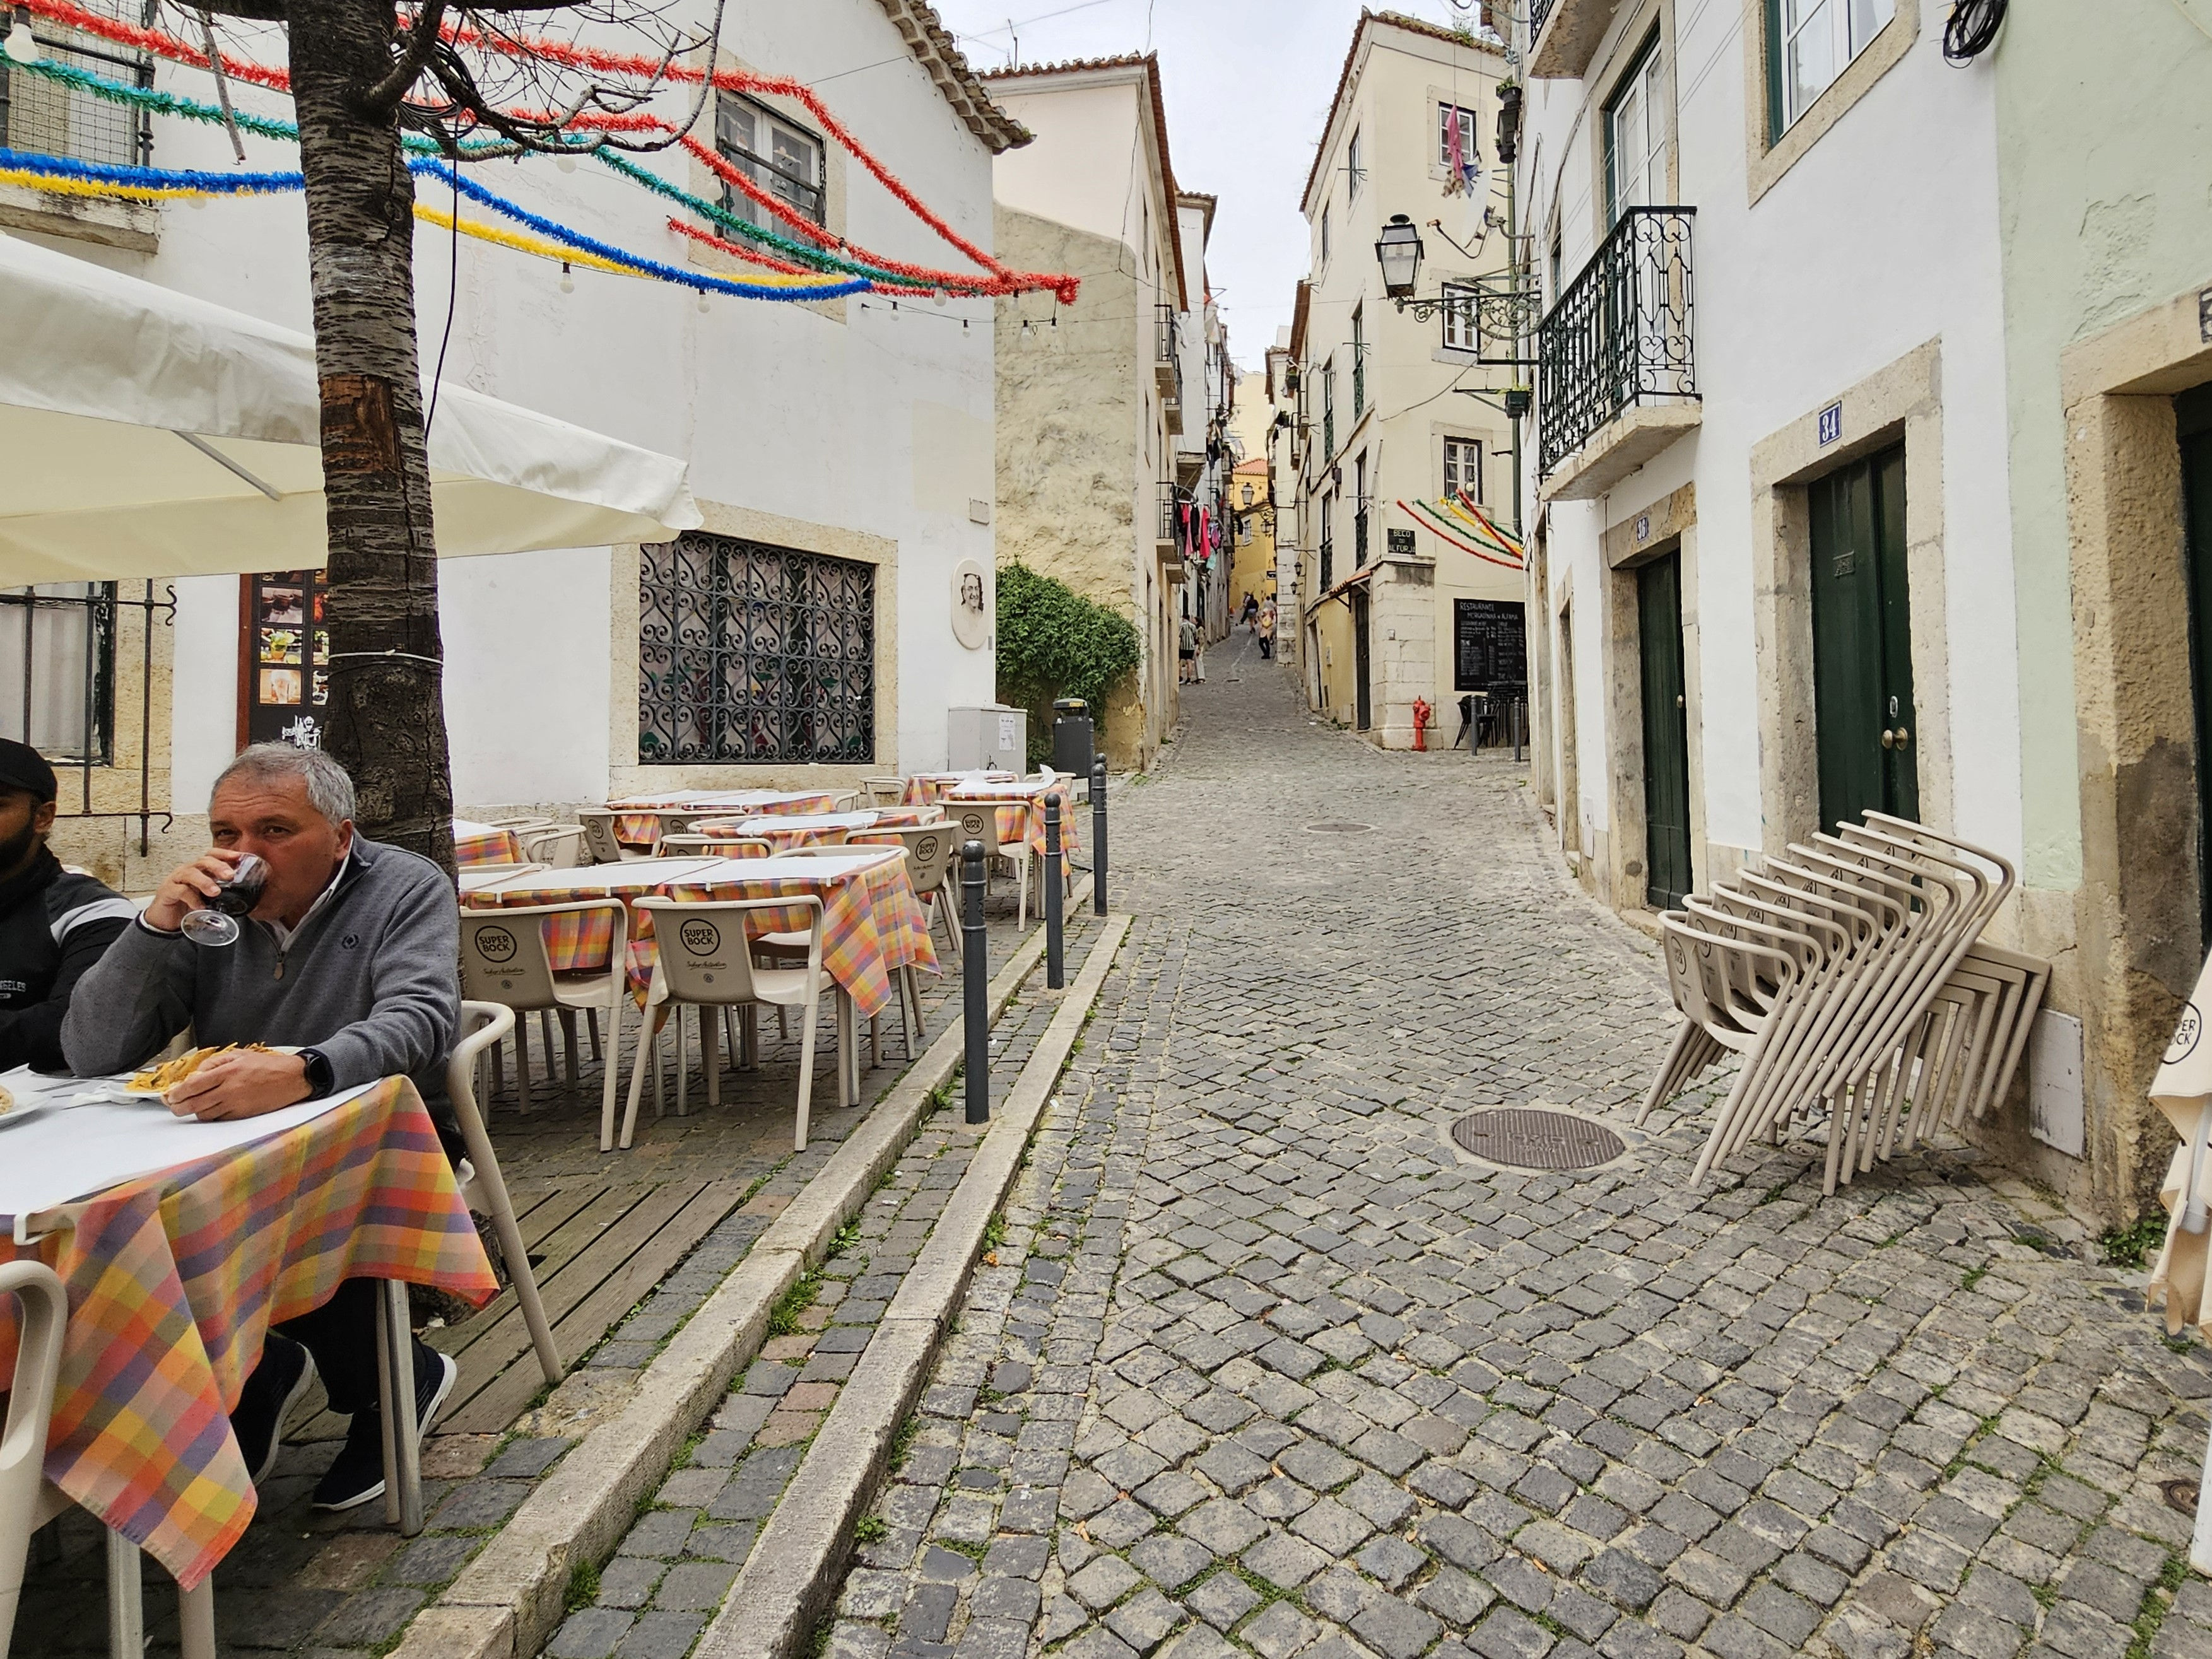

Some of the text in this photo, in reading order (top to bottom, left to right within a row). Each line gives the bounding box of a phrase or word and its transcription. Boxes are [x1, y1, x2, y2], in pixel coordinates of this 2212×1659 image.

[1821, 410, 1837, 442] 34
[1393, 529, 1411, 537] BECO
[1638, 519, 1645, 540] 36
[684, 929, 714, 937] SUPER
[479, 935, 510, 945] SUPER
[687, 937, 714, 945] BOCK
[483, 943, 510, 952] BOCK
